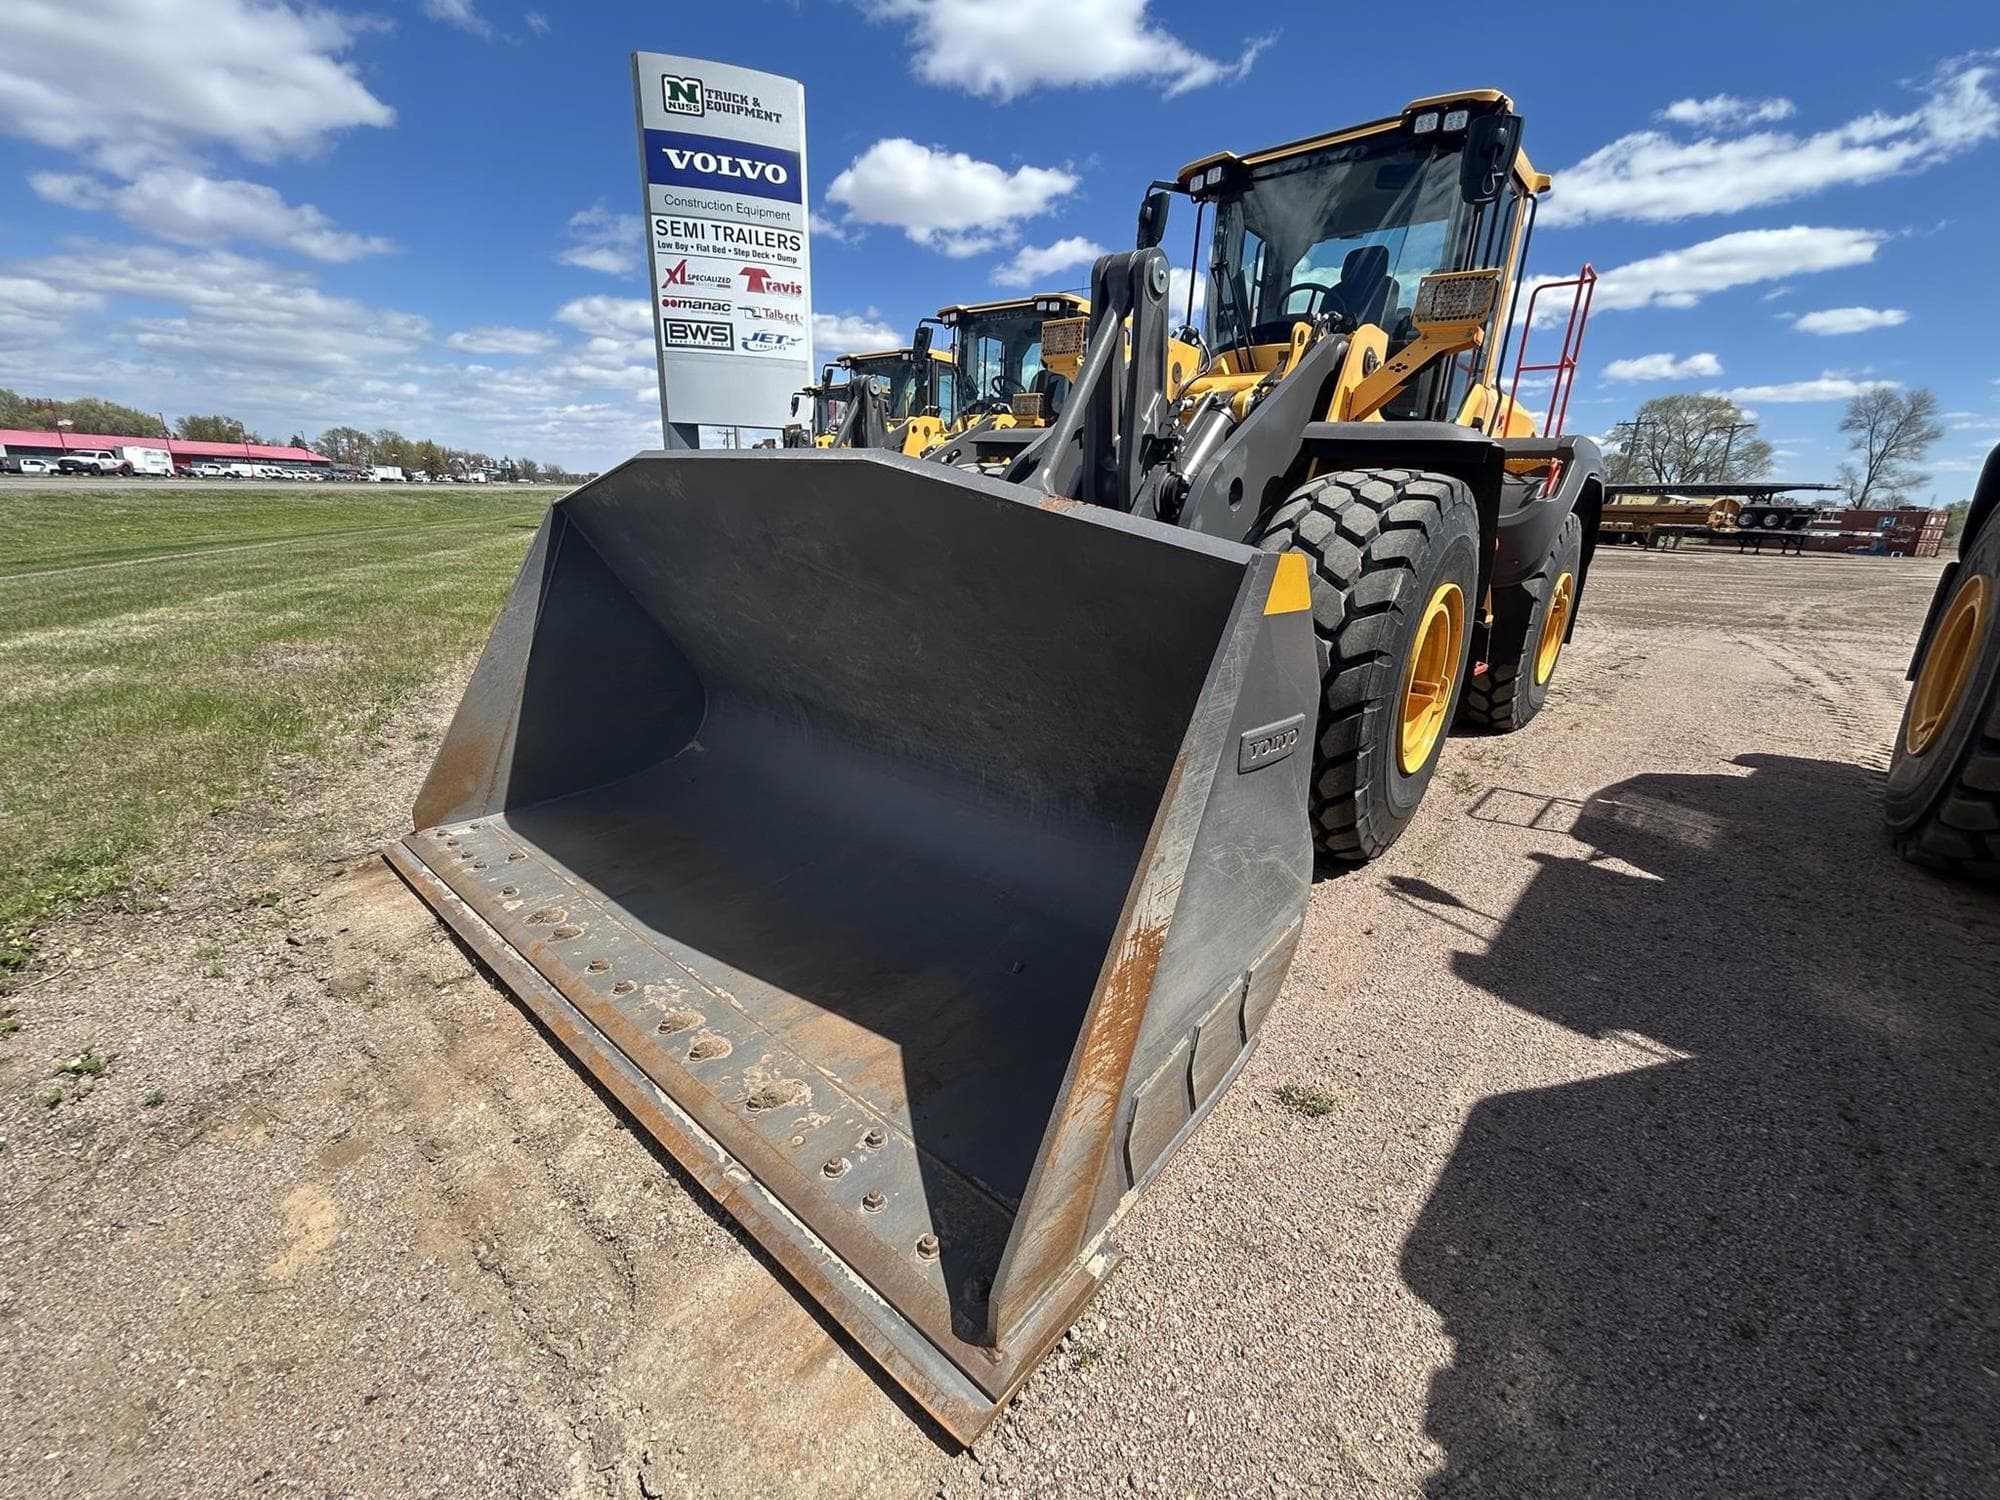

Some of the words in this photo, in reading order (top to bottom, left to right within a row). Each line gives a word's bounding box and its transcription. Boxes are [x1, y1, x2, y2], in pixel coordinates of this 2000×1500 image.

[668, 101, 700, 113] NUSS
[705, 88, 749, 106] TRUCK
[752, 97, 761, 108] &
[706, 100, 782, 124] EQUIPMENT
[662, 148, 788, 185] VOLVO
[664, 194, 733, 212] Construction
[736, 202, 791, 222] Equipment
[656, 219, 705, 240] SEMI
[711, 225, 800, 251] TRAILERS
[657, 240, 673, 250] Low
[674, 241, 689, 252] Boy
[696, 244, 710, 253] Flat
[712, 245, 726, 254] Bed
[733, 247, 751, 258] Step
[752, 249, 770, 260] Deck
[777, 253, 798, 264] Dump
[661, 259, 694, 289] XL
[687, 273, 732, 284] SPECIALIZED
[738, 266, 803, 296] Travis
[762, 307, 801, 322] Talbert
[669, 323, 728, 342] BWS
[752, 332, 788, 344] JET
[1250, 728, 1299, 759] VOLVO
